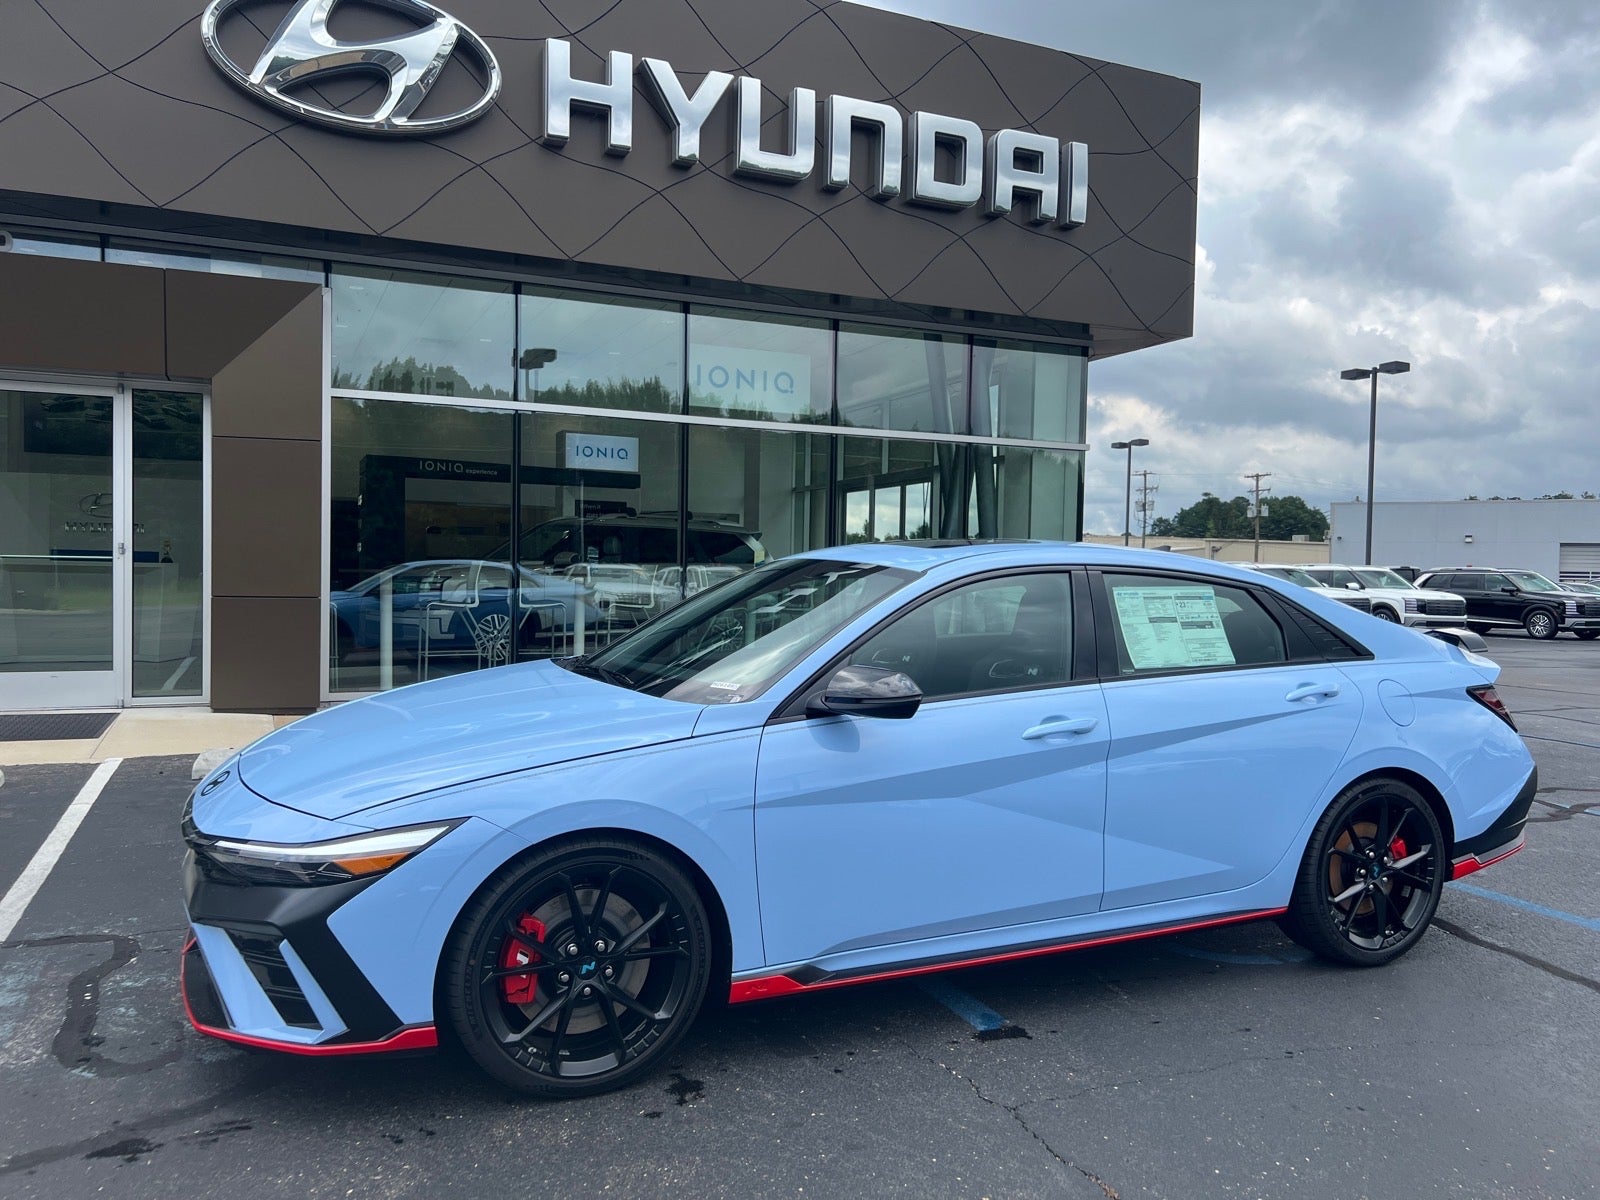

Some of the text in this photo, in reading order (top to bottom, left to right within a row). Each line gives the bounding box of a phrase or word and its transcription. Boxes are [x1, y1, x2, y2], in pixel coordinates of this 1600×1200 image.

[542, 38, 1090, 229] HYUNDAI
[697, 365, 794, 394] IONIQ
[576, 445, 628, 460] IONIQ
[420, 461, 464, 473] IONIQ
